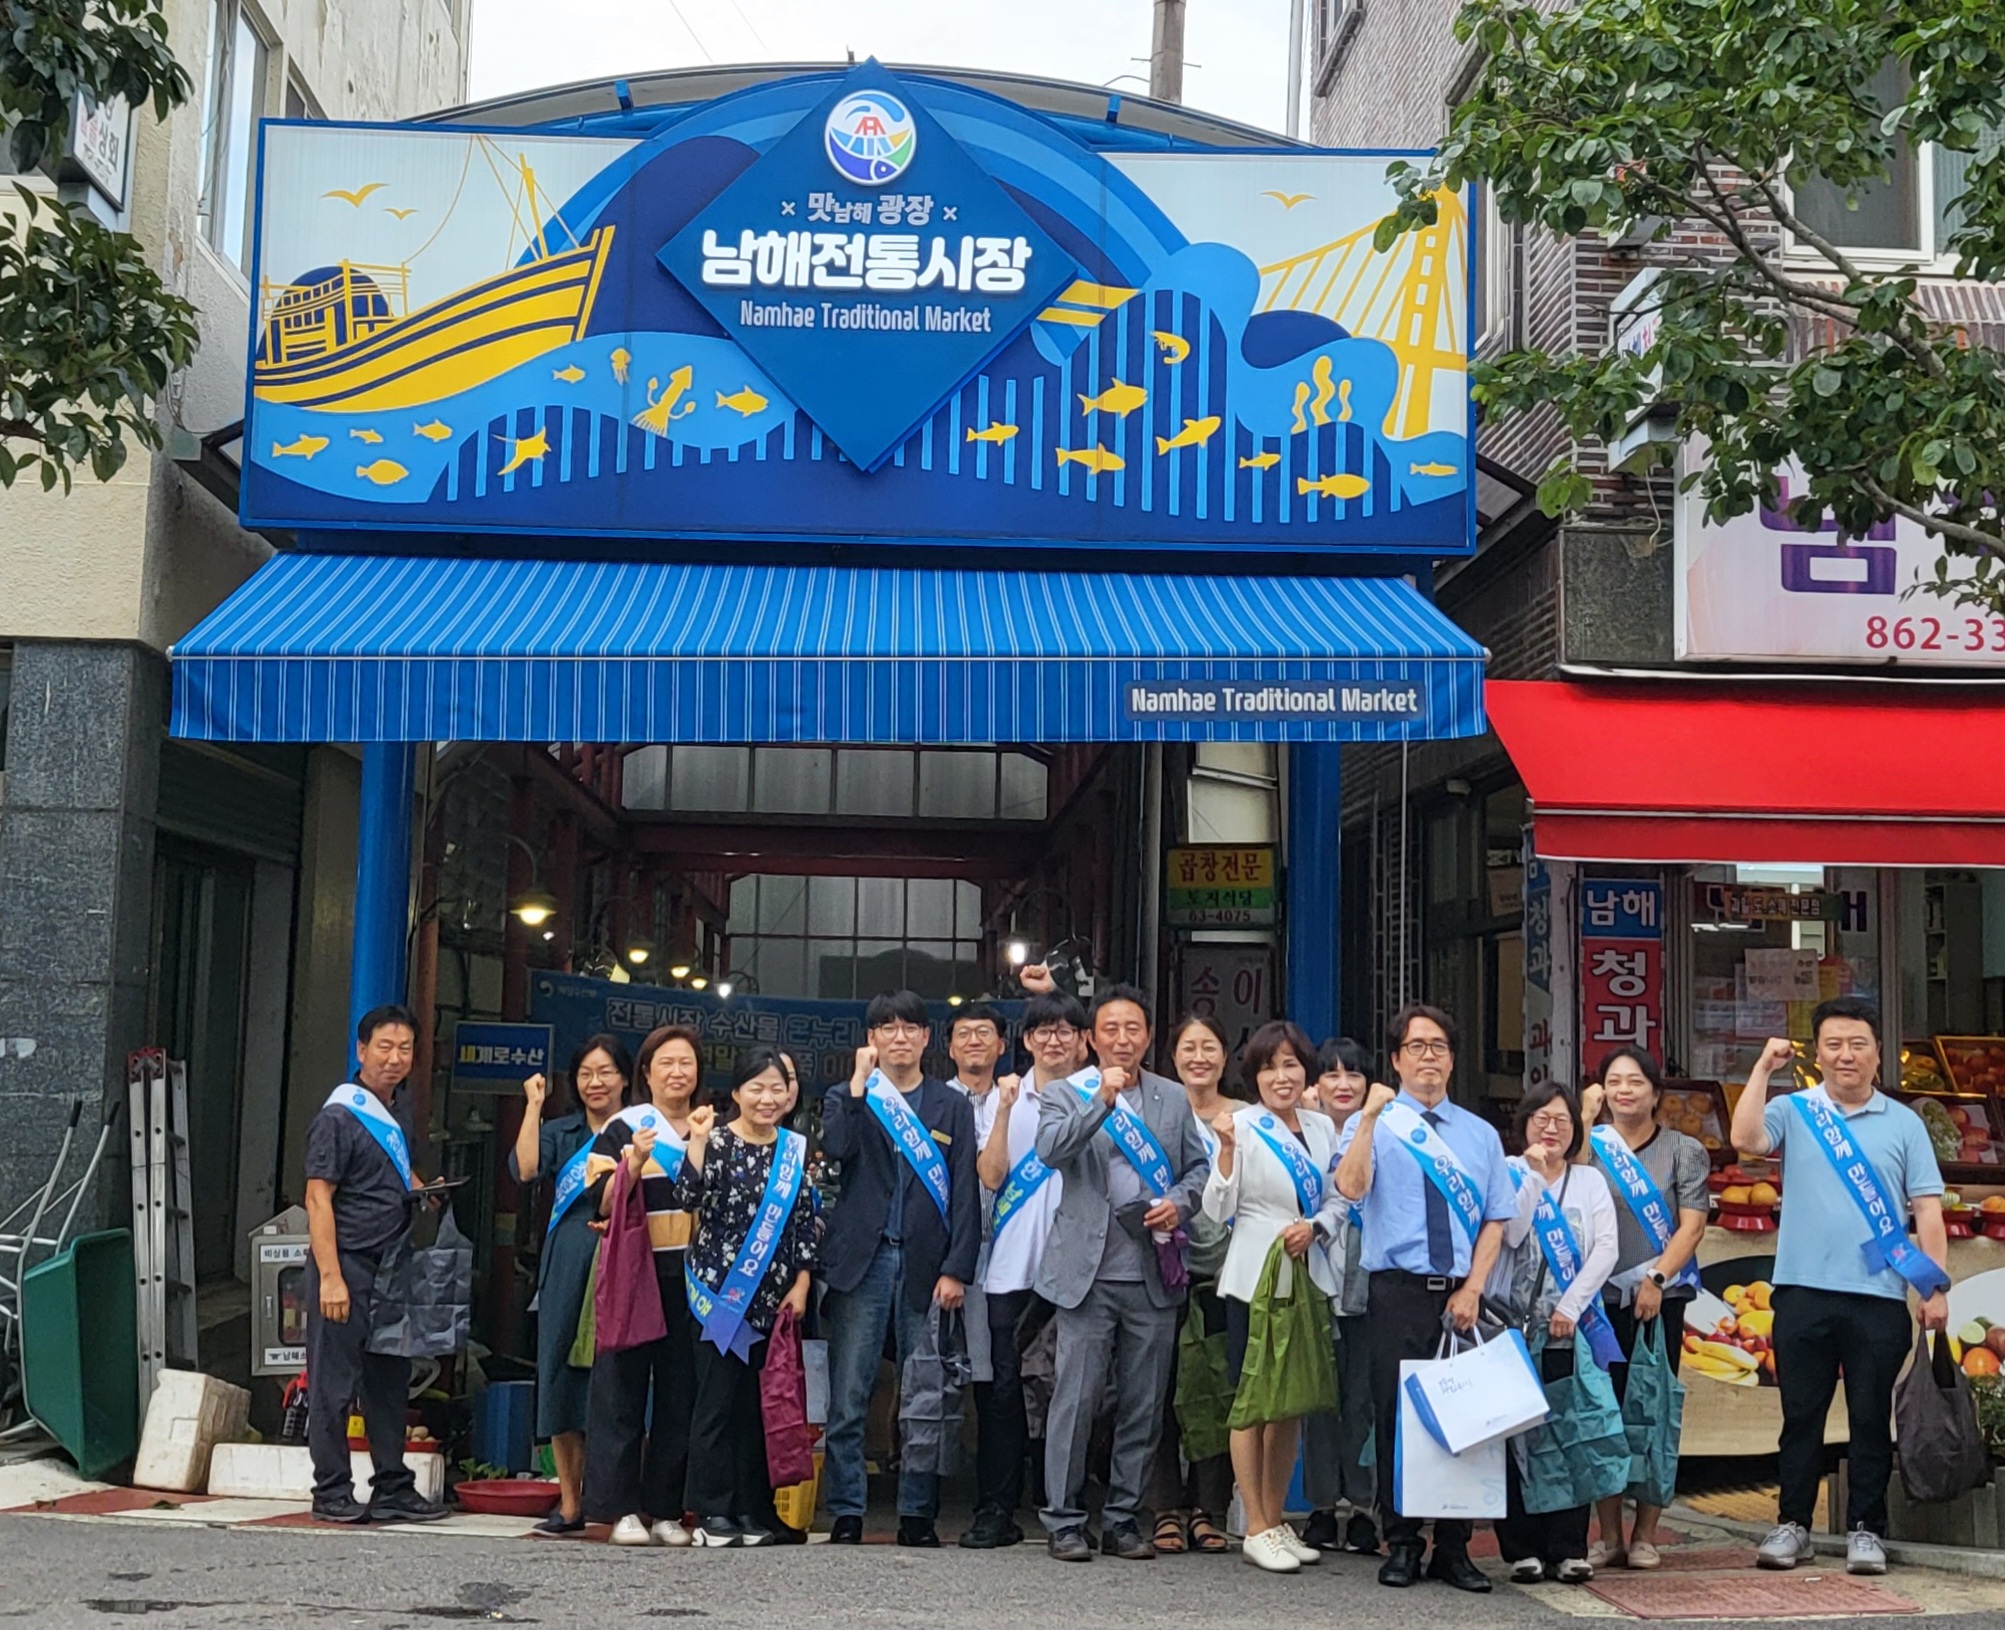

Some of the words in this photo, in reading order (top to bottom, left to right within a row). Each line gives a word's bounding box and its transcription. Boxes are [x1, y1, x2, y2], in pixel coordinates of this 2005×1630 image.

[877, 194, 934, 226] 광장
[701, 229, 1032, 292] 남해전통시장
[740, 300, 815, 328] Namhae
[821, 302, 920, 331] Traditional
[925, 306, 991, 333] Market
[1131, 687, 1216, 712] Namhae
[1222, 687, 1336, 712] Traditional
[1341, 688, 1418, 712] Market
[1179, 851, 1262, 883] 곱창전문
[1586, 887, 1657, 928] 남해
[1592, 949, 1657, 1050] 청과
[708, 1010, 779, 1043] 수산물
[787, 1016, 858, 1047] 온누리
[882, 1096, 933, 1163] 우리함께
[1112, 1111, 1157, 1165] 리함께
[773, 1135, 799, 1199] 우리함께
[1605, 1140, 1649, 1198] 우리함께
[1807, 1096, 1853, 1160] 우리함께
[1847, 1162, 1895, 1238] 만들어요
[737, 1204, 783, 1277] 만들어요
